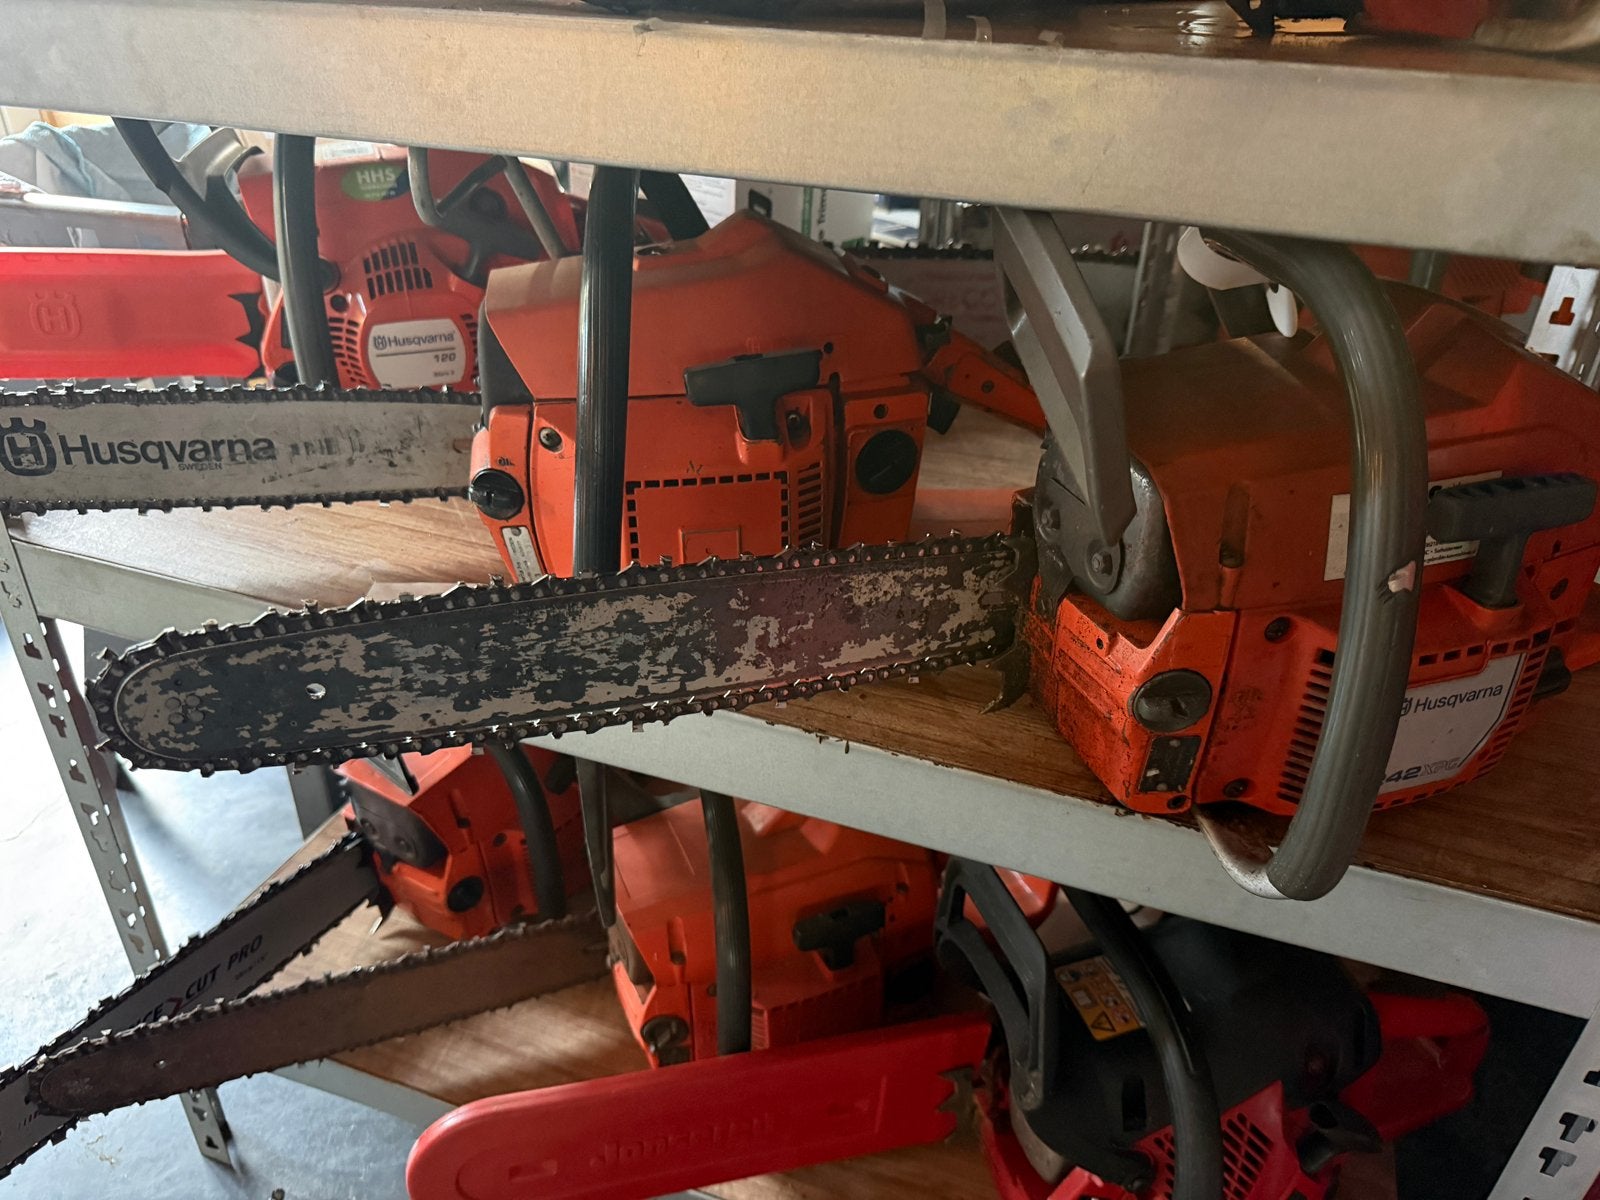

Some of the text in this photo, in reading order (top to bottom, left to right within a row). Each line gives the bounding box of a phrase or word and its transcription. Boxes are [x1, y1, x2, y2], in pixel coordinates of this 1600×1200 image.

[355, 167, 396, 185] HHS
[387, 332, 455, 347] Husqvarna
[433, 352, 457, 364] 120
[58, 434, 278, 471] Husqvarna
[178, 462, 222, 471] SWEDEN
[1413, 684, 1504, 714] Husqvarna
[185, 962, 222, 1000] CUT
[226, 934, 263, 971] PRO
